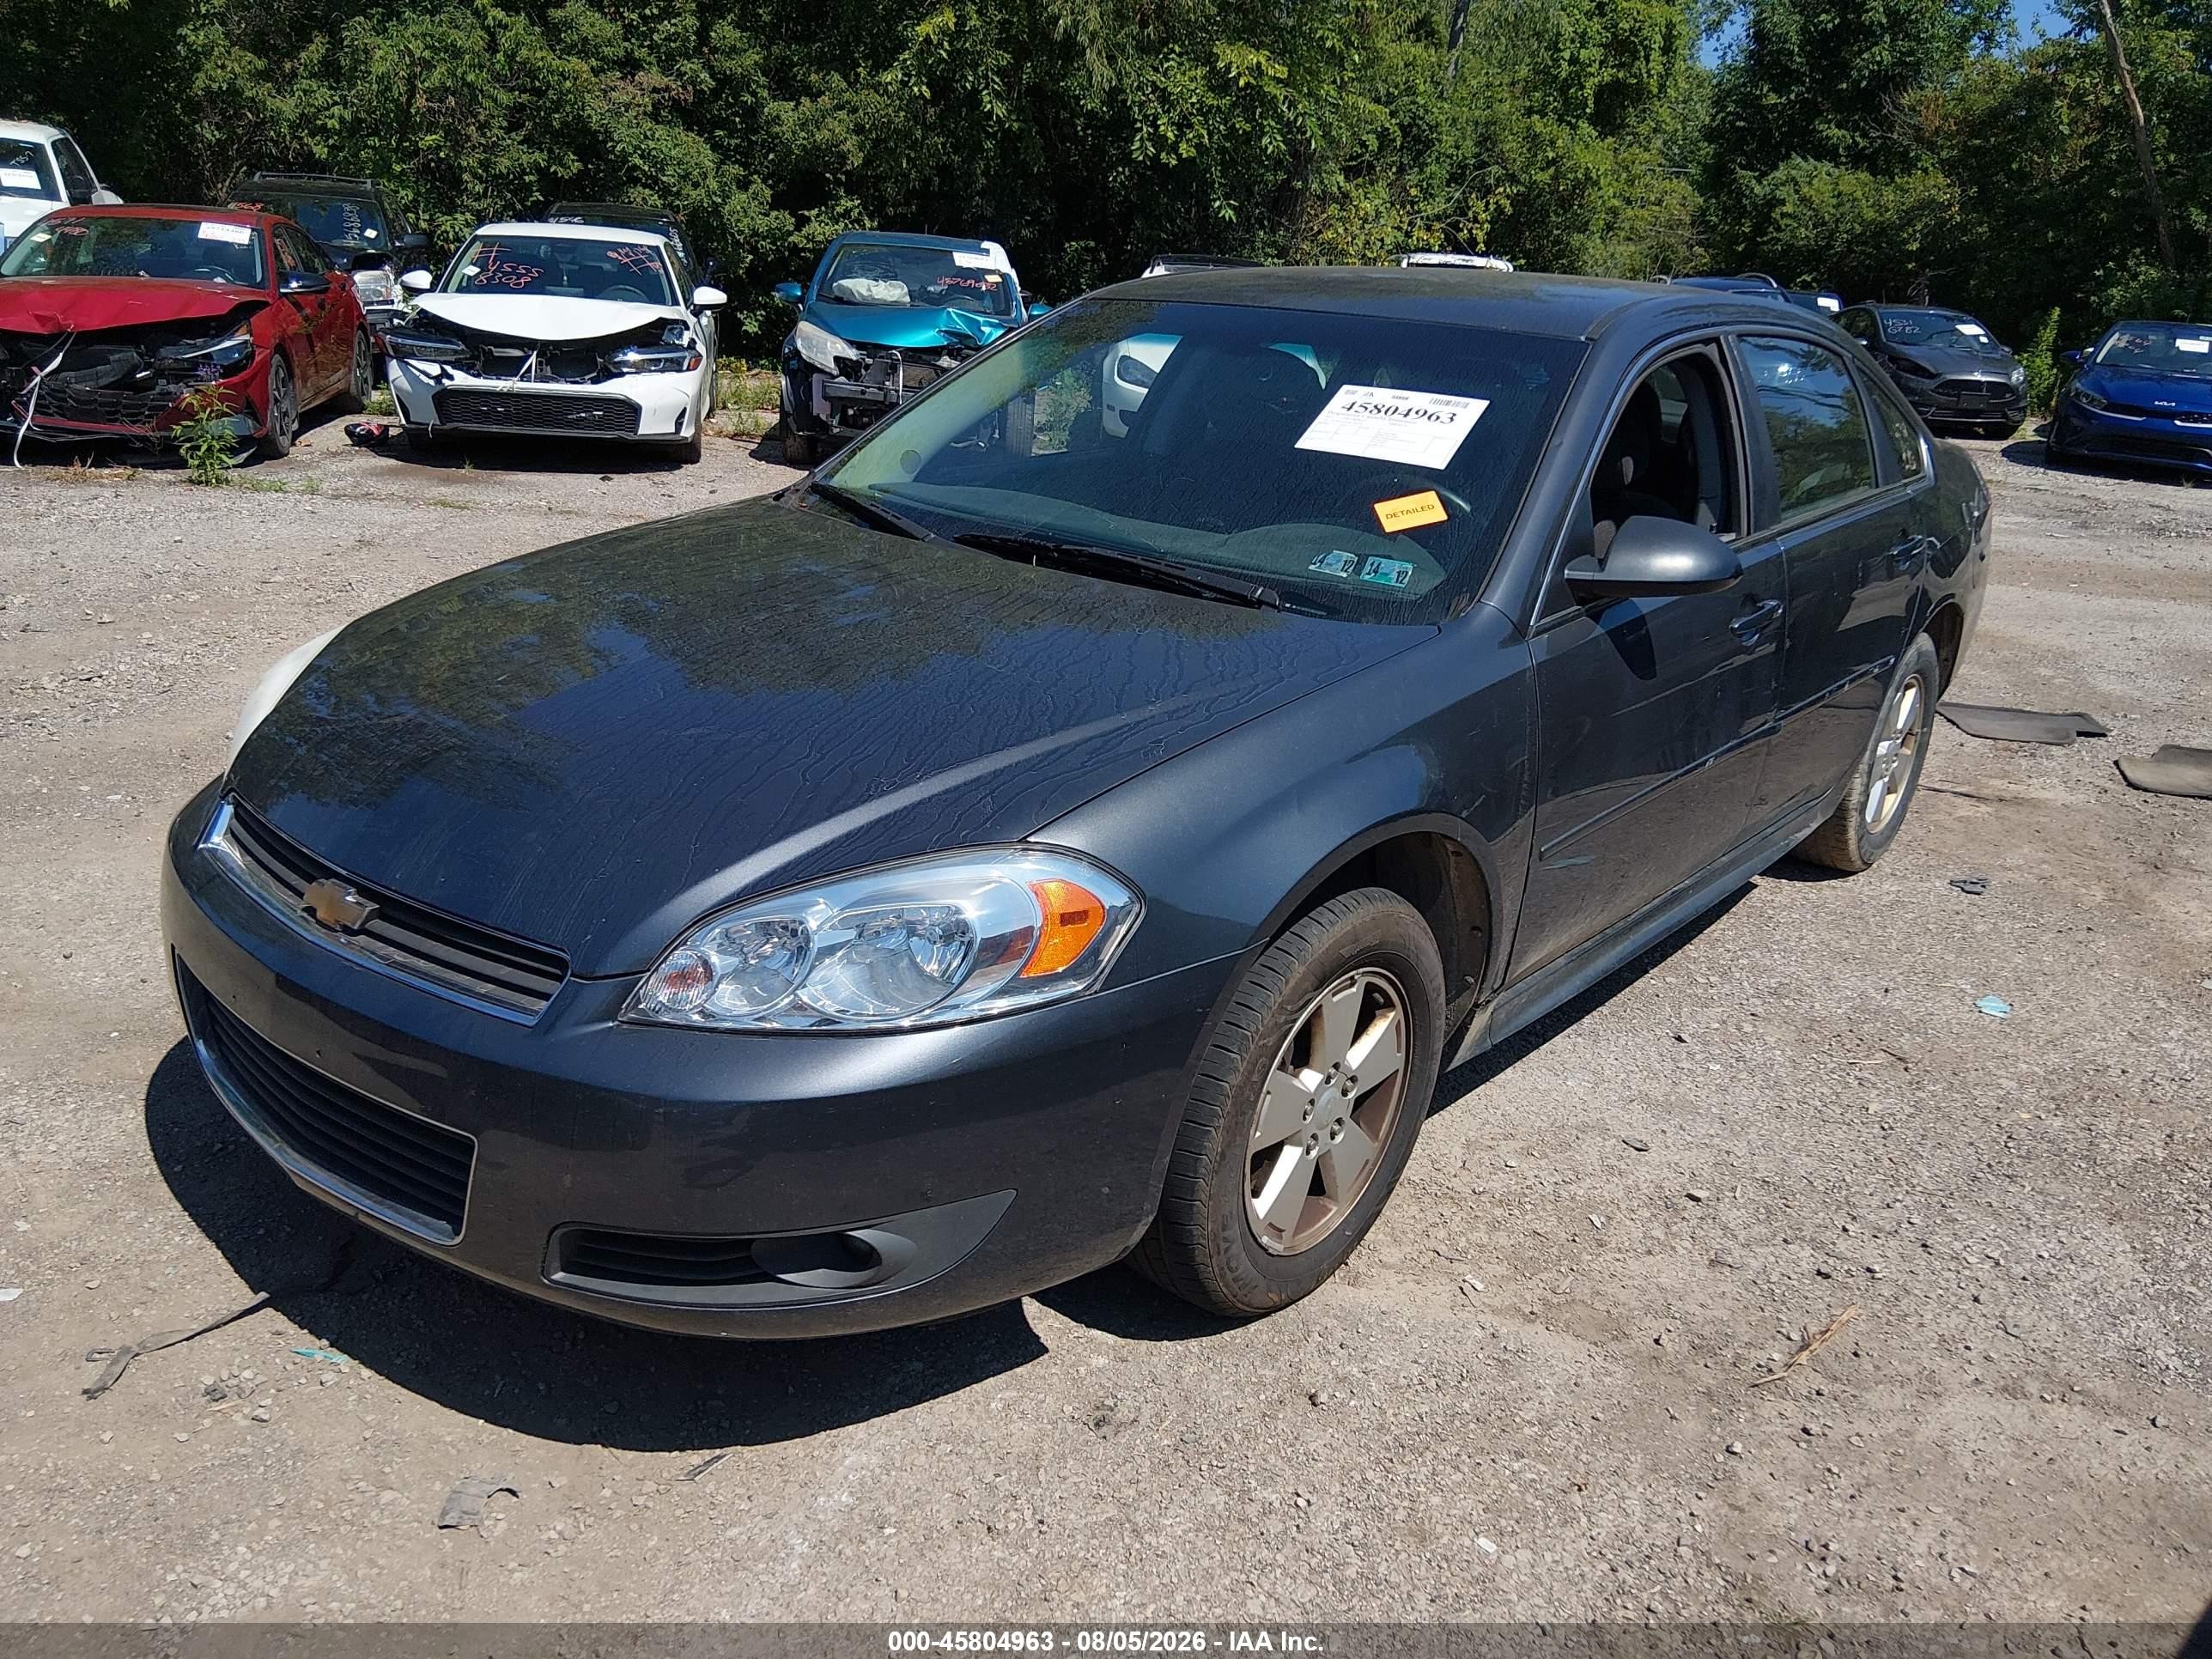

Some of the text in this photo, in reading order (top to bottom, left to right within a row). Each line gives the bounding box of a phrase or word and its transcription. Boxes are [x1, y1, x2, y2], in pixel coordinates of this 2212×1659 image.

[474, 271, 532, 289] 8308
[1341, 400, 1457, 425] 45804963
[1385, 503, 1436, 520] DETAILED
[1340, 559, 1357, 574] 12
[1365, 560, 1409, 585] 14 12
